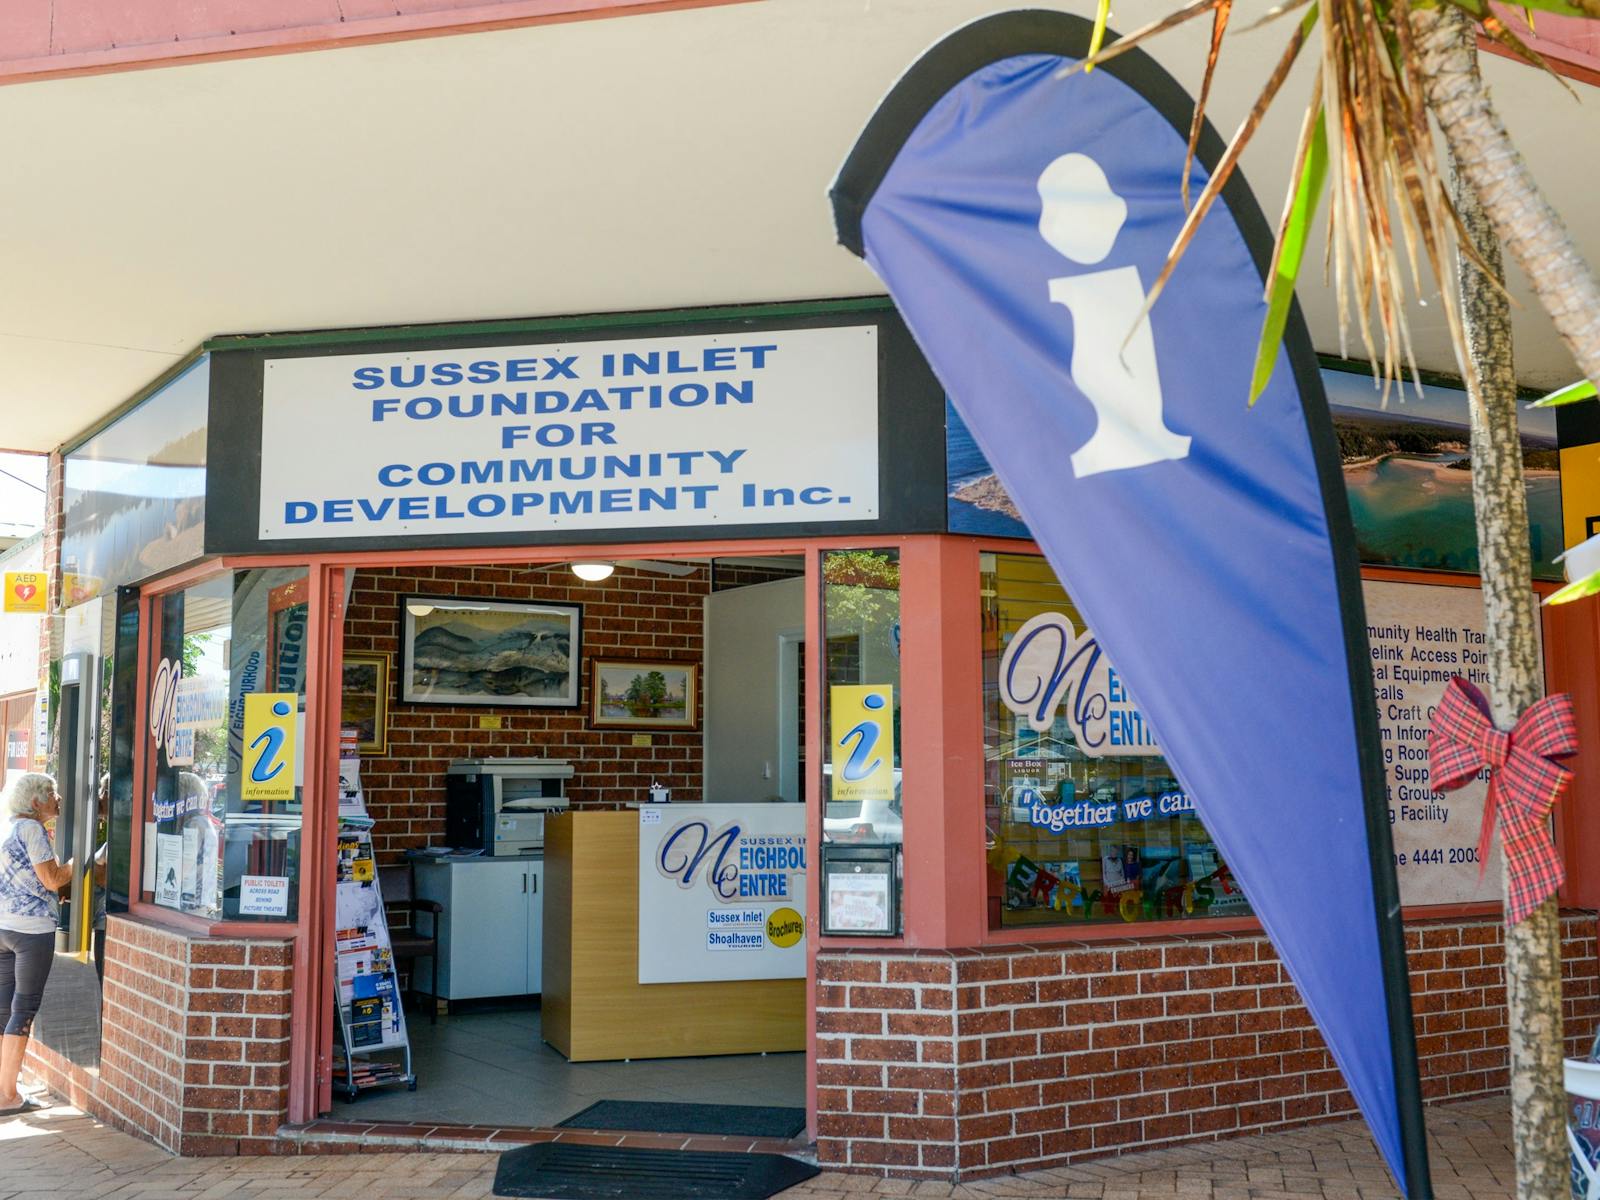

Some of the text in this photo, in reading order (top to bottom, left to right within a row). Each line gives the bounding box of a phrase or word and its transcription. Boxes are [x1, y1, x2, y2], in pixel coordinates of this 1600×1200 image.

[352, 345, 778, 390] SUSSEX INLET
[372, 380, 753, 422] FOUNDATION
[502, 422, 618, 449] FOR
[378, 449, 748, 487] COMMUNITY
[284, 484, 852, 524] DEVELOPMENT Inc.
[15, 574, 37, 583] AED
[1416, 625, 1458, 643] Health
[1369, 644, 1404, 661] elink
[1411, 646, 1457, 663] Access
[1388, 704, 1422, 721] Craft
[246, 787, 290, 796] information
[837, 788, 889, 796] information
[1124, 799, 1152, 819] we
[1401, 805, 1448, 824] Facility
[740, 837, 792, 846] SUSSEX
[1412, 848, 1444, 865] 4441
[244, 879, 285, 888] PUBLIC TOILETS
[740, 873, 787, 897] ENTRE
[709, 911, 762, 923] Sussex Inlet
[709, 932, 762, 944] Shoalhaven
[768, 920, 803, 938] Brochures
